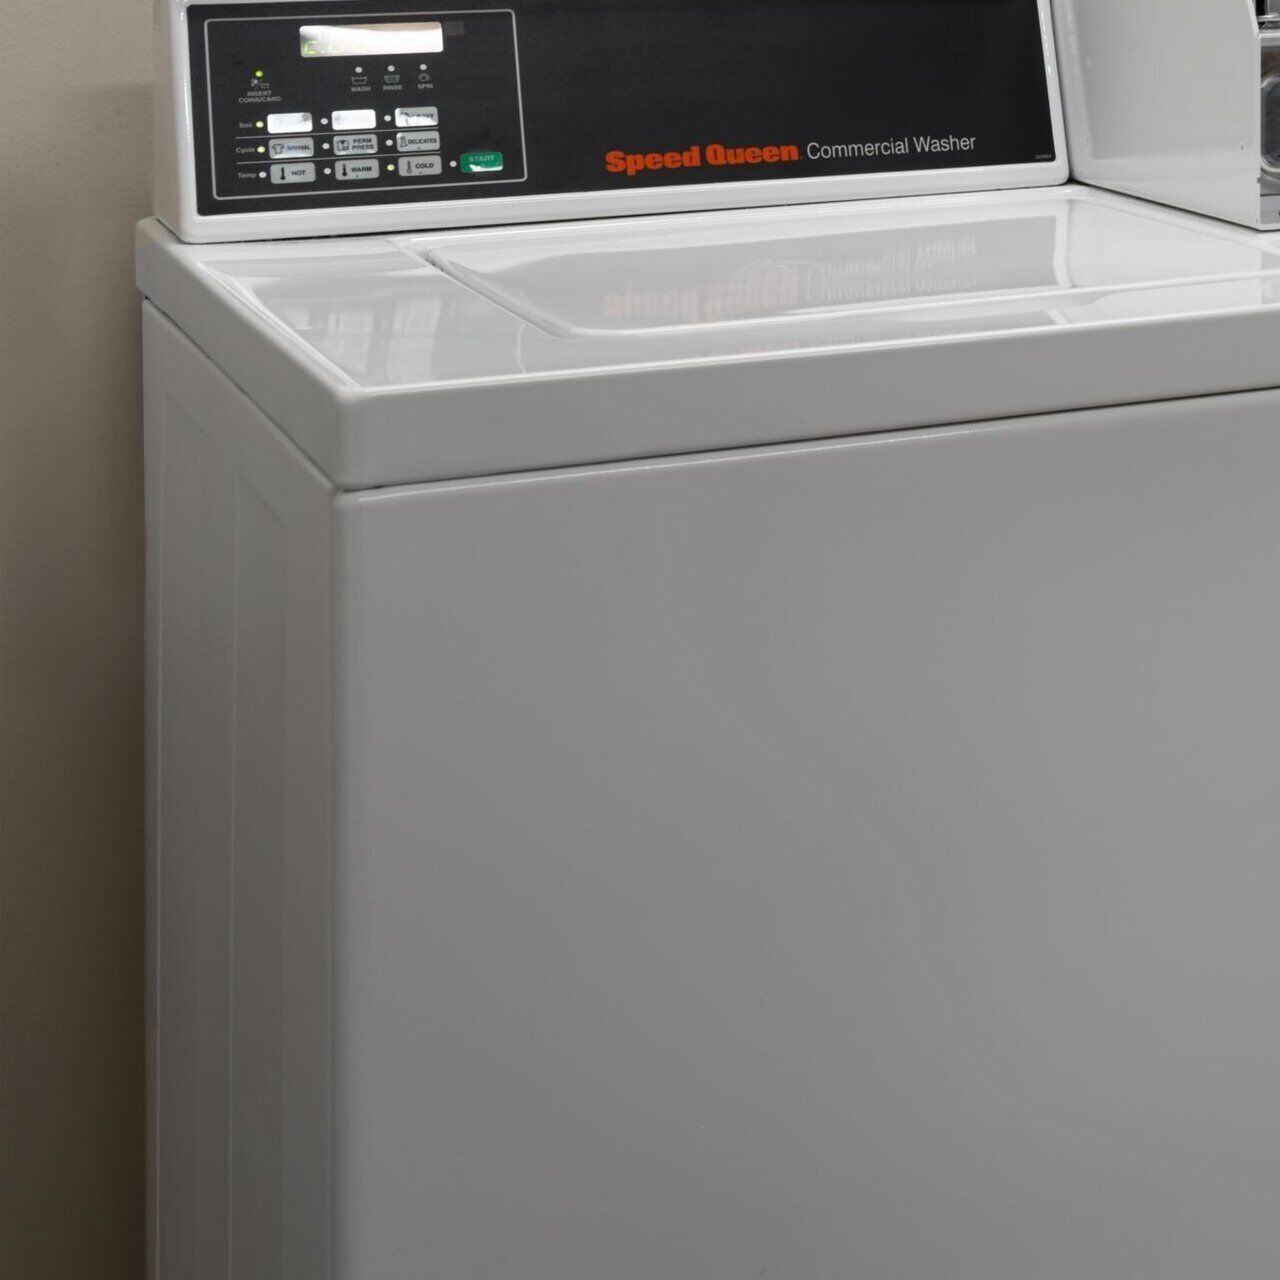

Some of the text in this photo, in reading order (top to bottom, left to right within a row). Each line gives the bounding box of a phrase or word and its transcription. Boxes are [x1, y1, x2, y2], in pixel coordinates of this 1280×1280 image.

[605, 134, 976, 176] Speed Queen Commercial Washer
